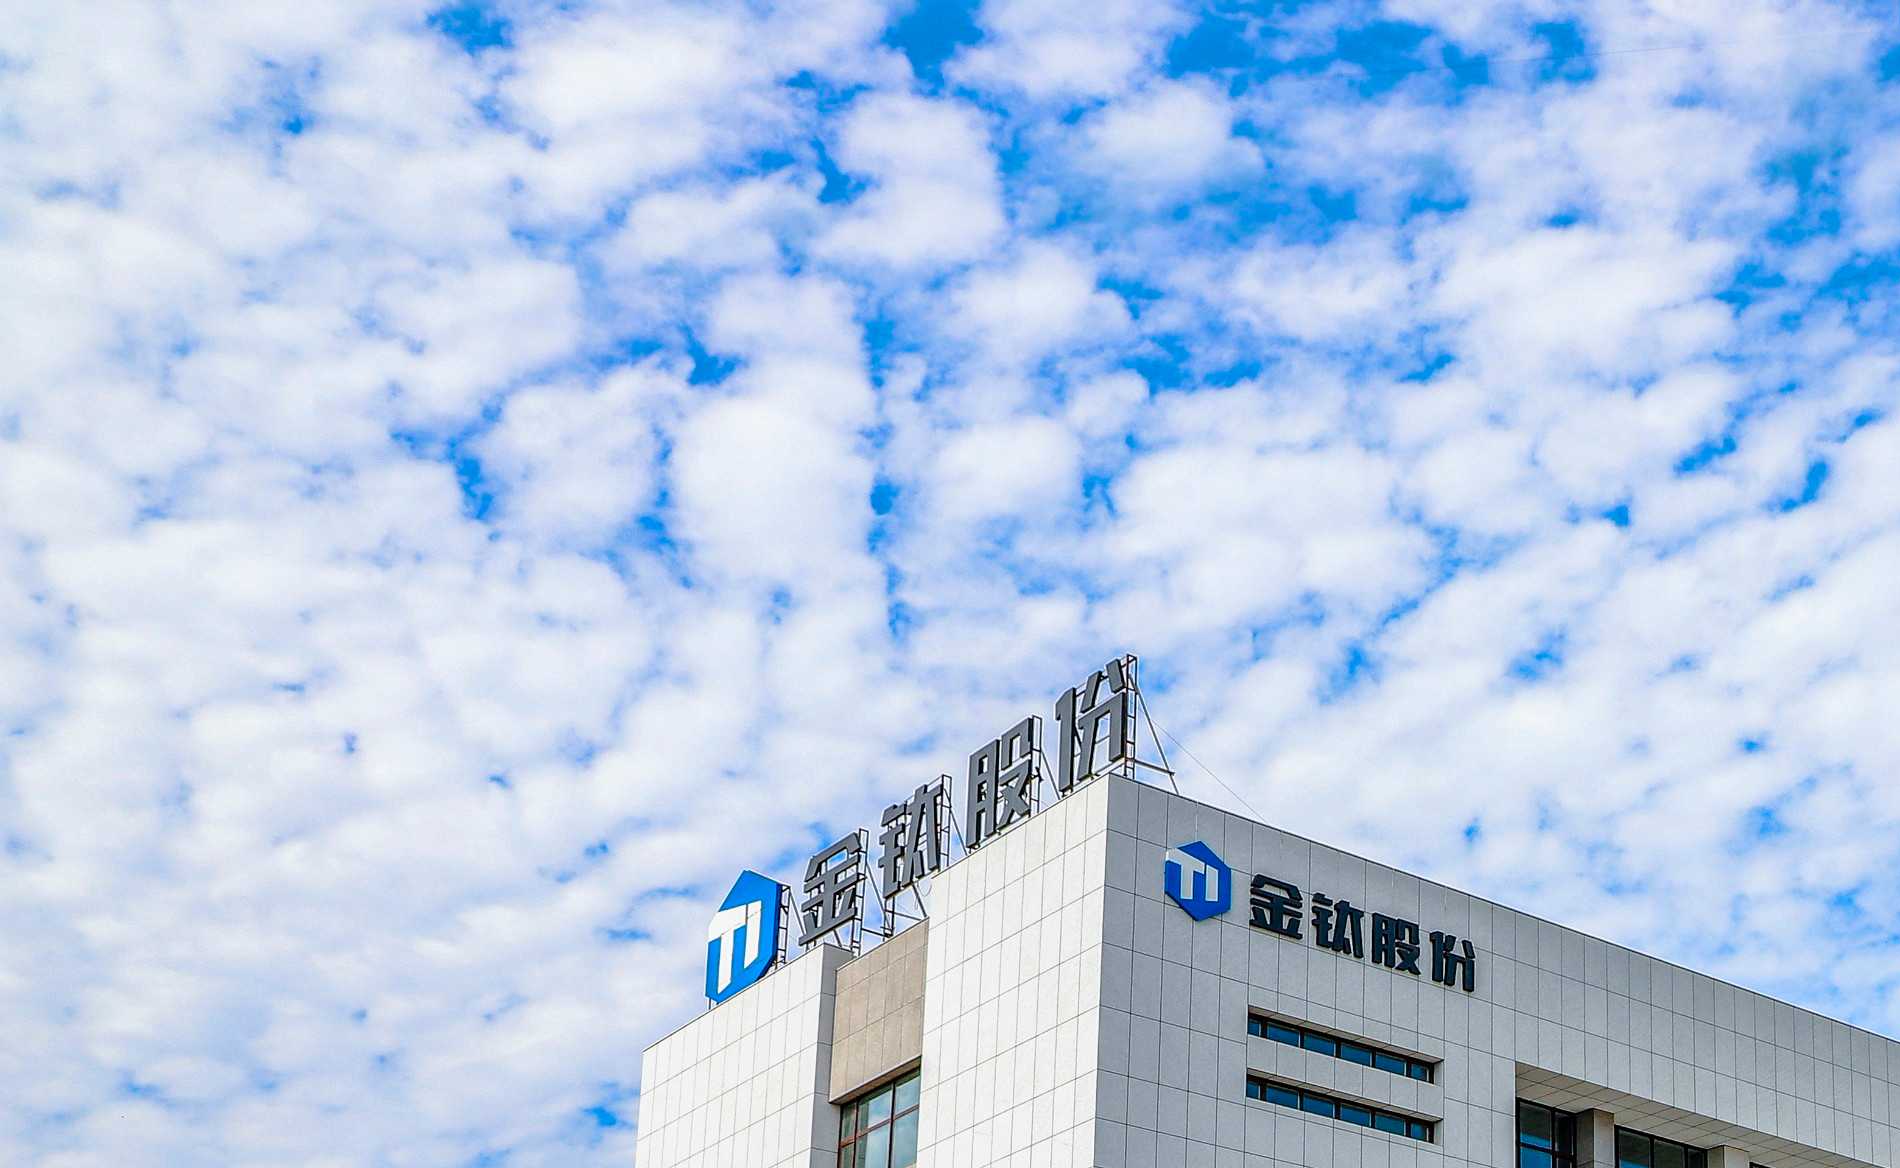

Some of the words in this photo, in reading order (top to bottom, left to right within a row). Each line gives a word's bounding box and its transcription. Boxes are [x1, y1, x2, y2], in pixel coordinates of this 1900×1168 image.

[800, 659, 1127, 946] 金钛股份
[1249, 874, 1476, 993] 金钛股份
